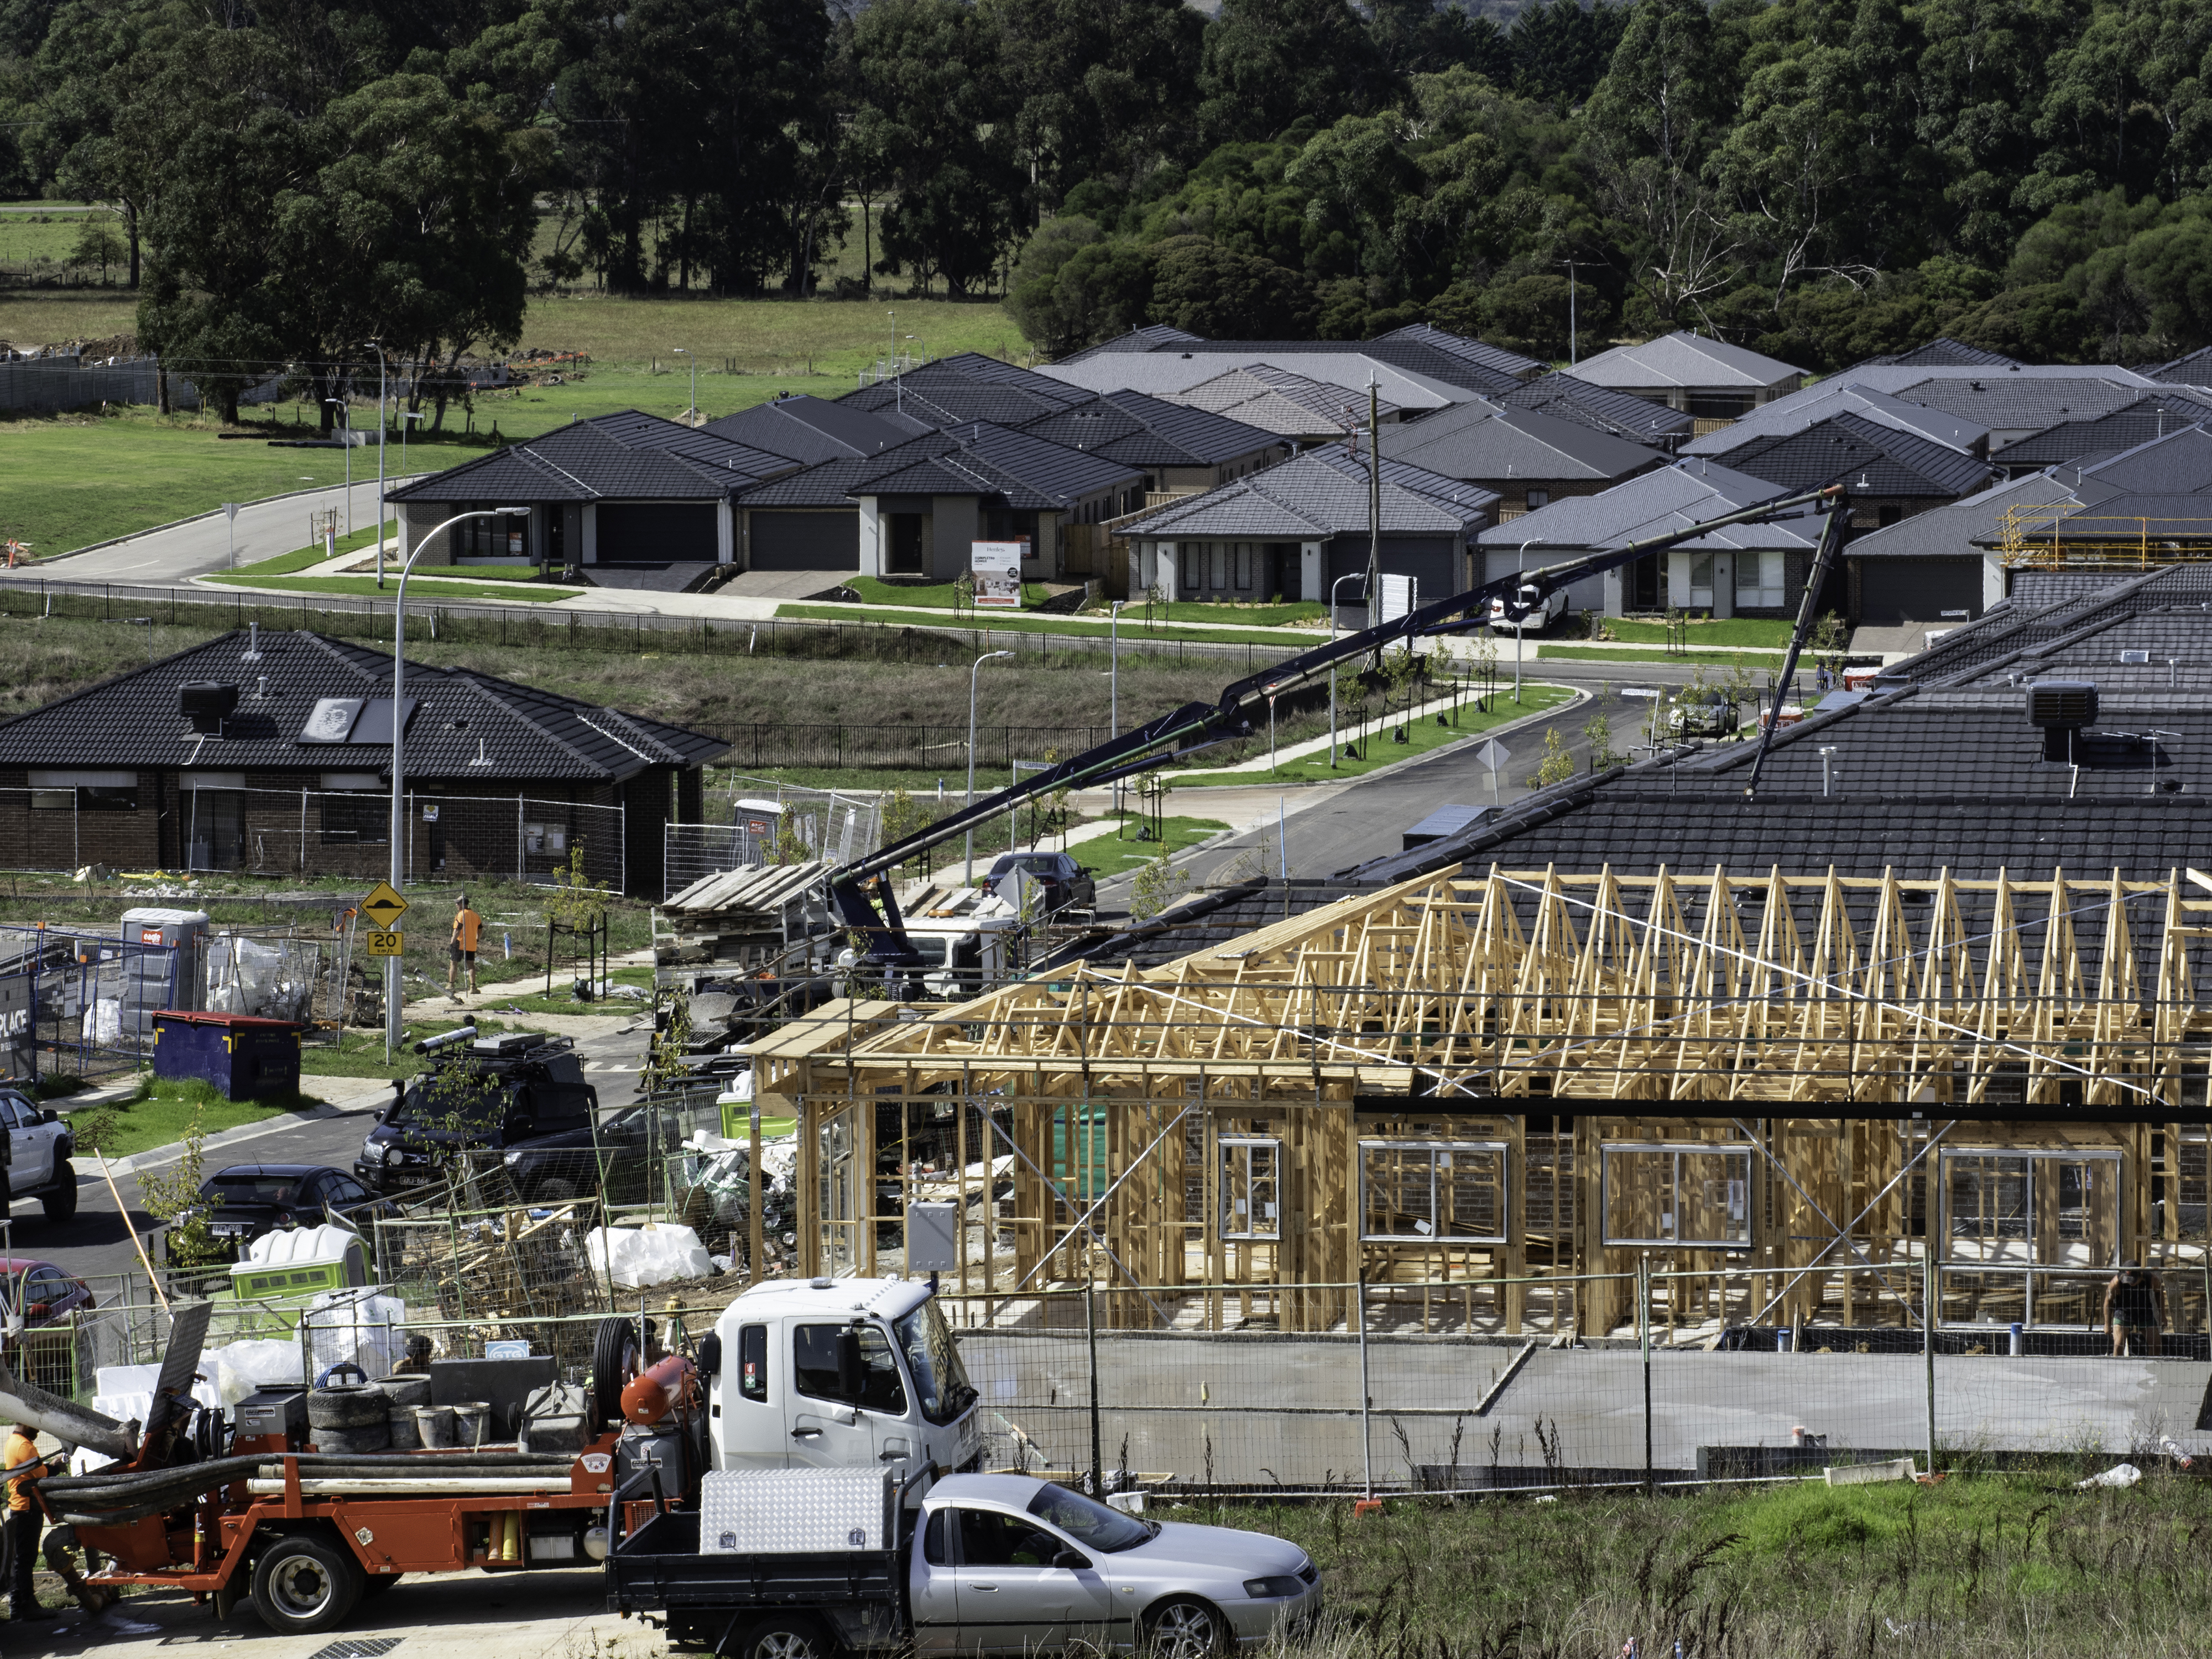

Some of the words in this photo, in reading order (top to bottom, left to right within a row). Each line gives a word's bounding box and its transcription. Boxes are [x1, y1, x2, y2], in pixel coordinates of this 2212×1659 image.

[143, 933, 161, 943] eagle
[374, 934, 397, 947] 20
[0, 1009, 27, 1038] PLACE
[492, 1350, 522, 1358] GTG
